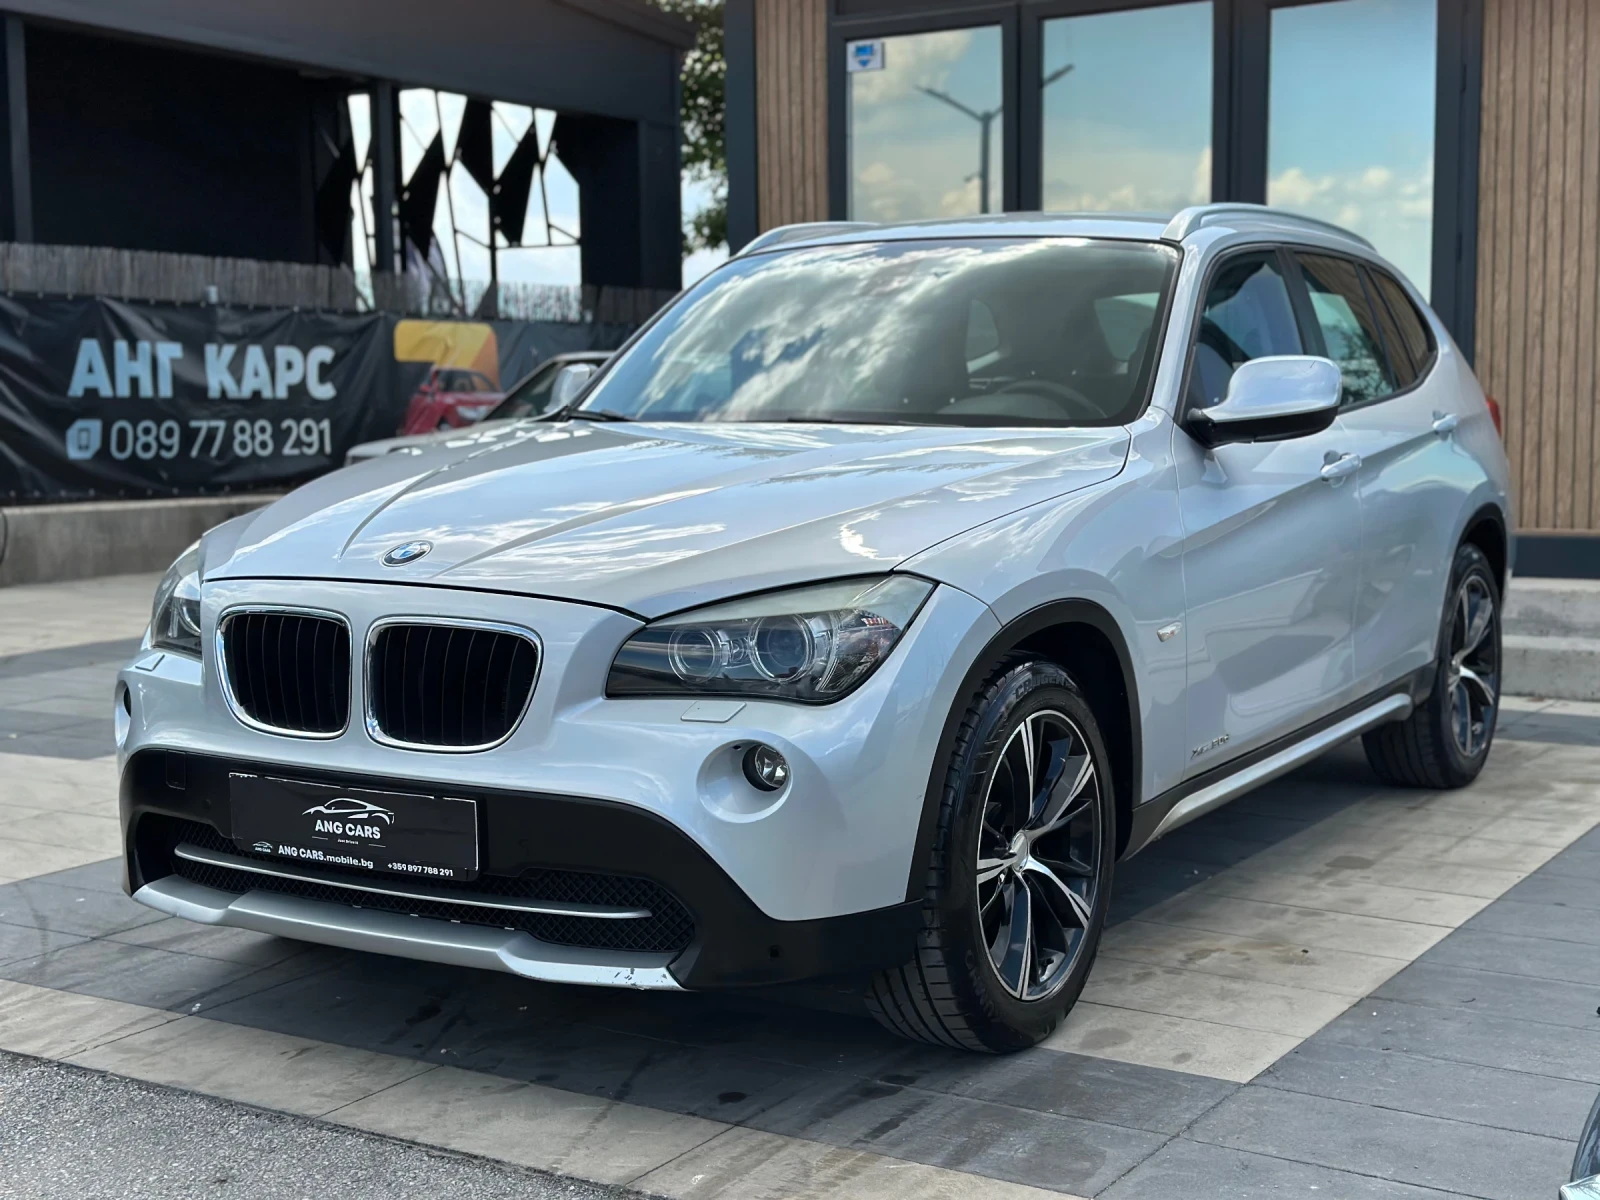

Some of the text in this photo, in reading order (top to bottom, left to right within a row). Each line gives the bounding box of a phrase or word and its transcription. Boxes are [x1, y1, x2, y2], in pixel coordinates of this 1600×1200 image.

[67, 338, 337, 400] АНГ КАРС
[110, 418, 332, 459] 089 77 88 291
[315, 819, 381, 840] ANG CARS
[278, 845, 374, 869] ANG CARS.mobile.bg
[387, 862, 454, 877] +359 897 788 291
